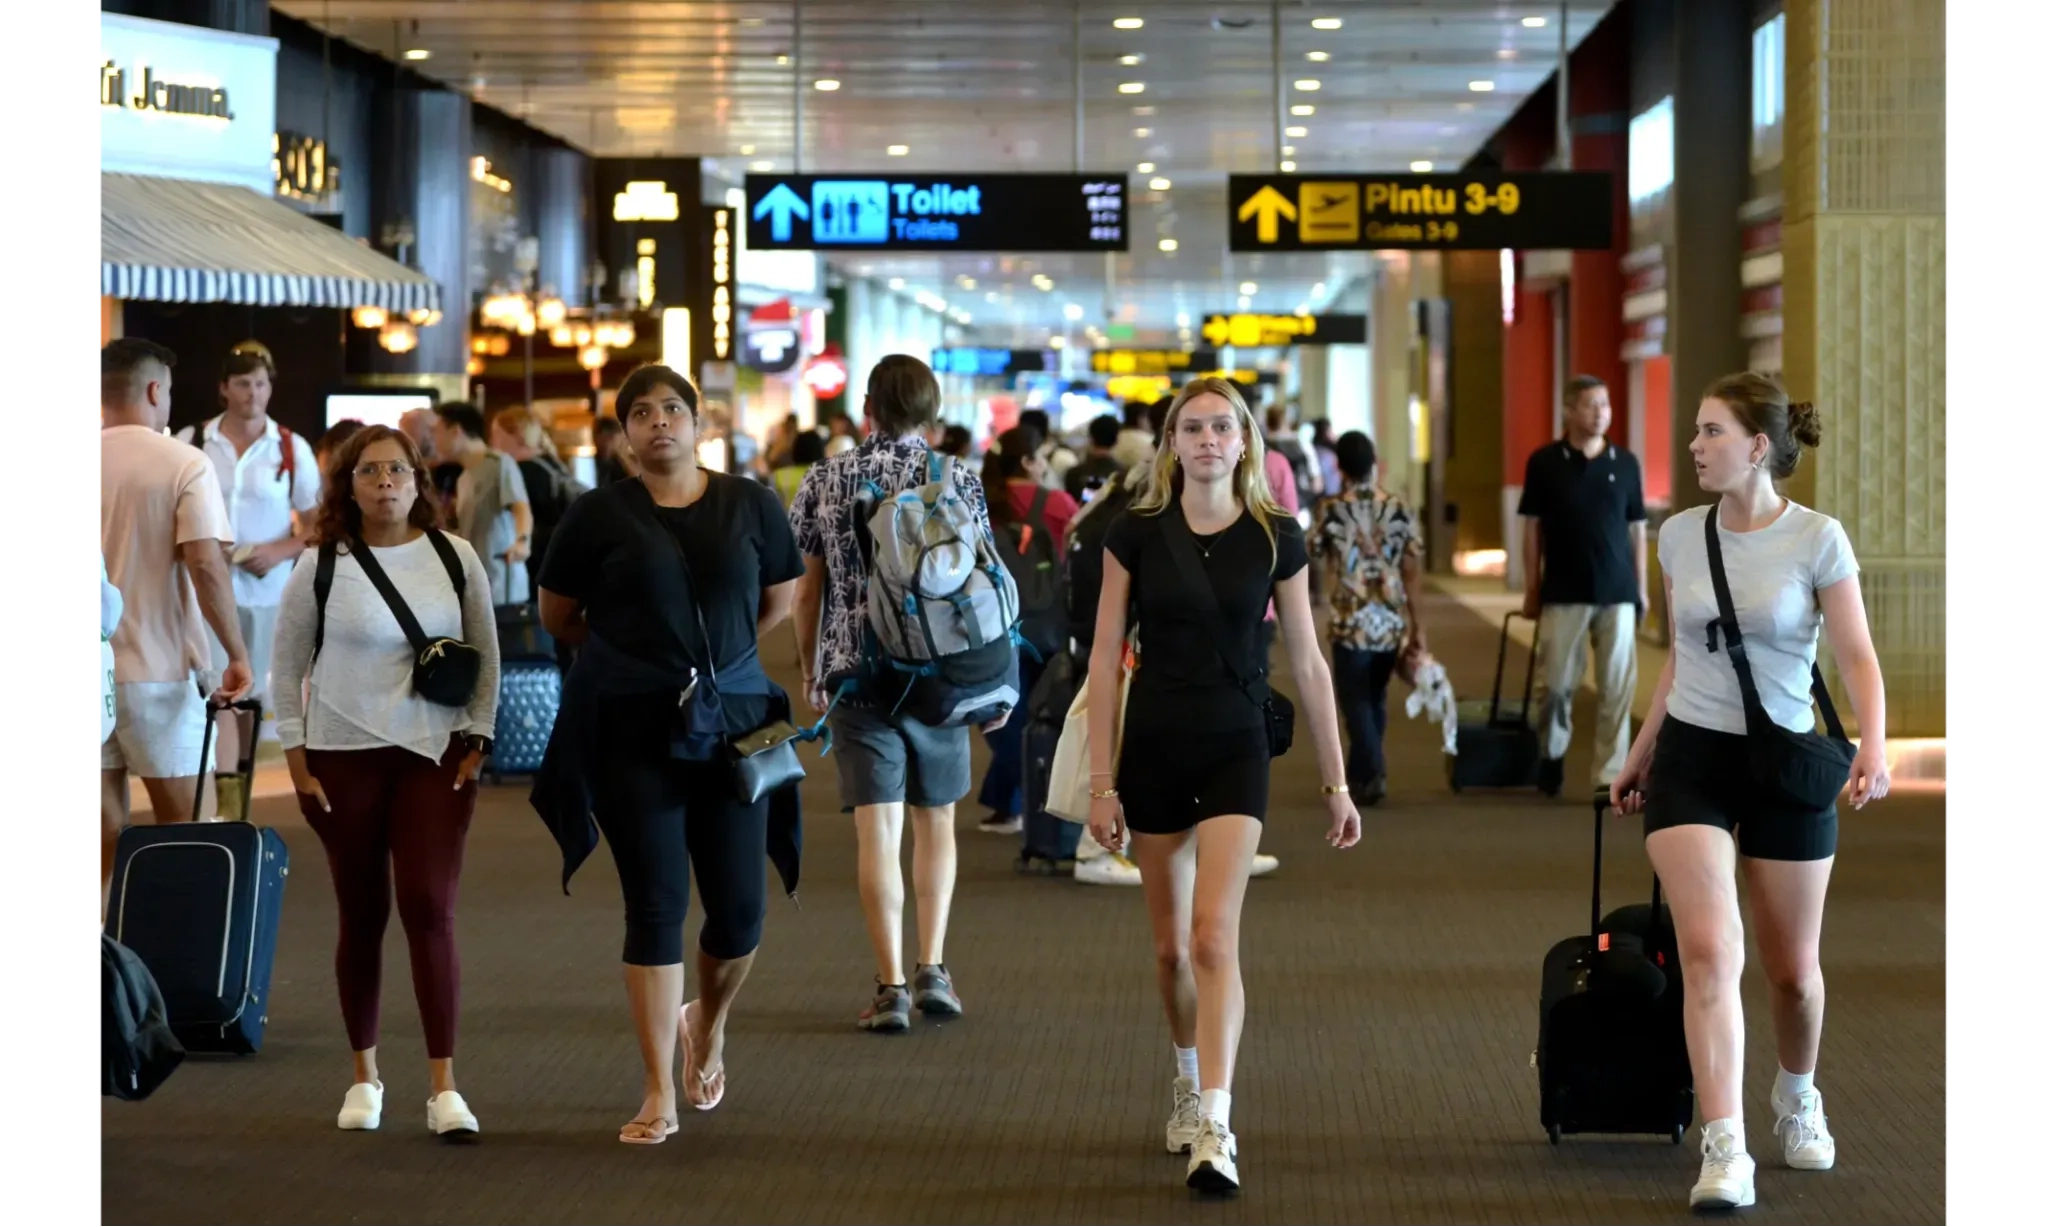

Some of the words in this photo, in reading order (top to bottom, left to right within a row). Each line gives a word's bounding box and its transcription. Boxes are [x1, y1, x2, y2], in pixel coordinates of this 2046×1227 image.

[891, 183, 982, 215] Toilet
[1366, 182, 1457, 215] Pintu
[1464, 182, 1520, 215] 3-9
[892, 217, 959, 241] Toilets
[1366, 221, 1423, 241] Gates
[1426, 221, 1459, 241] 3-9
